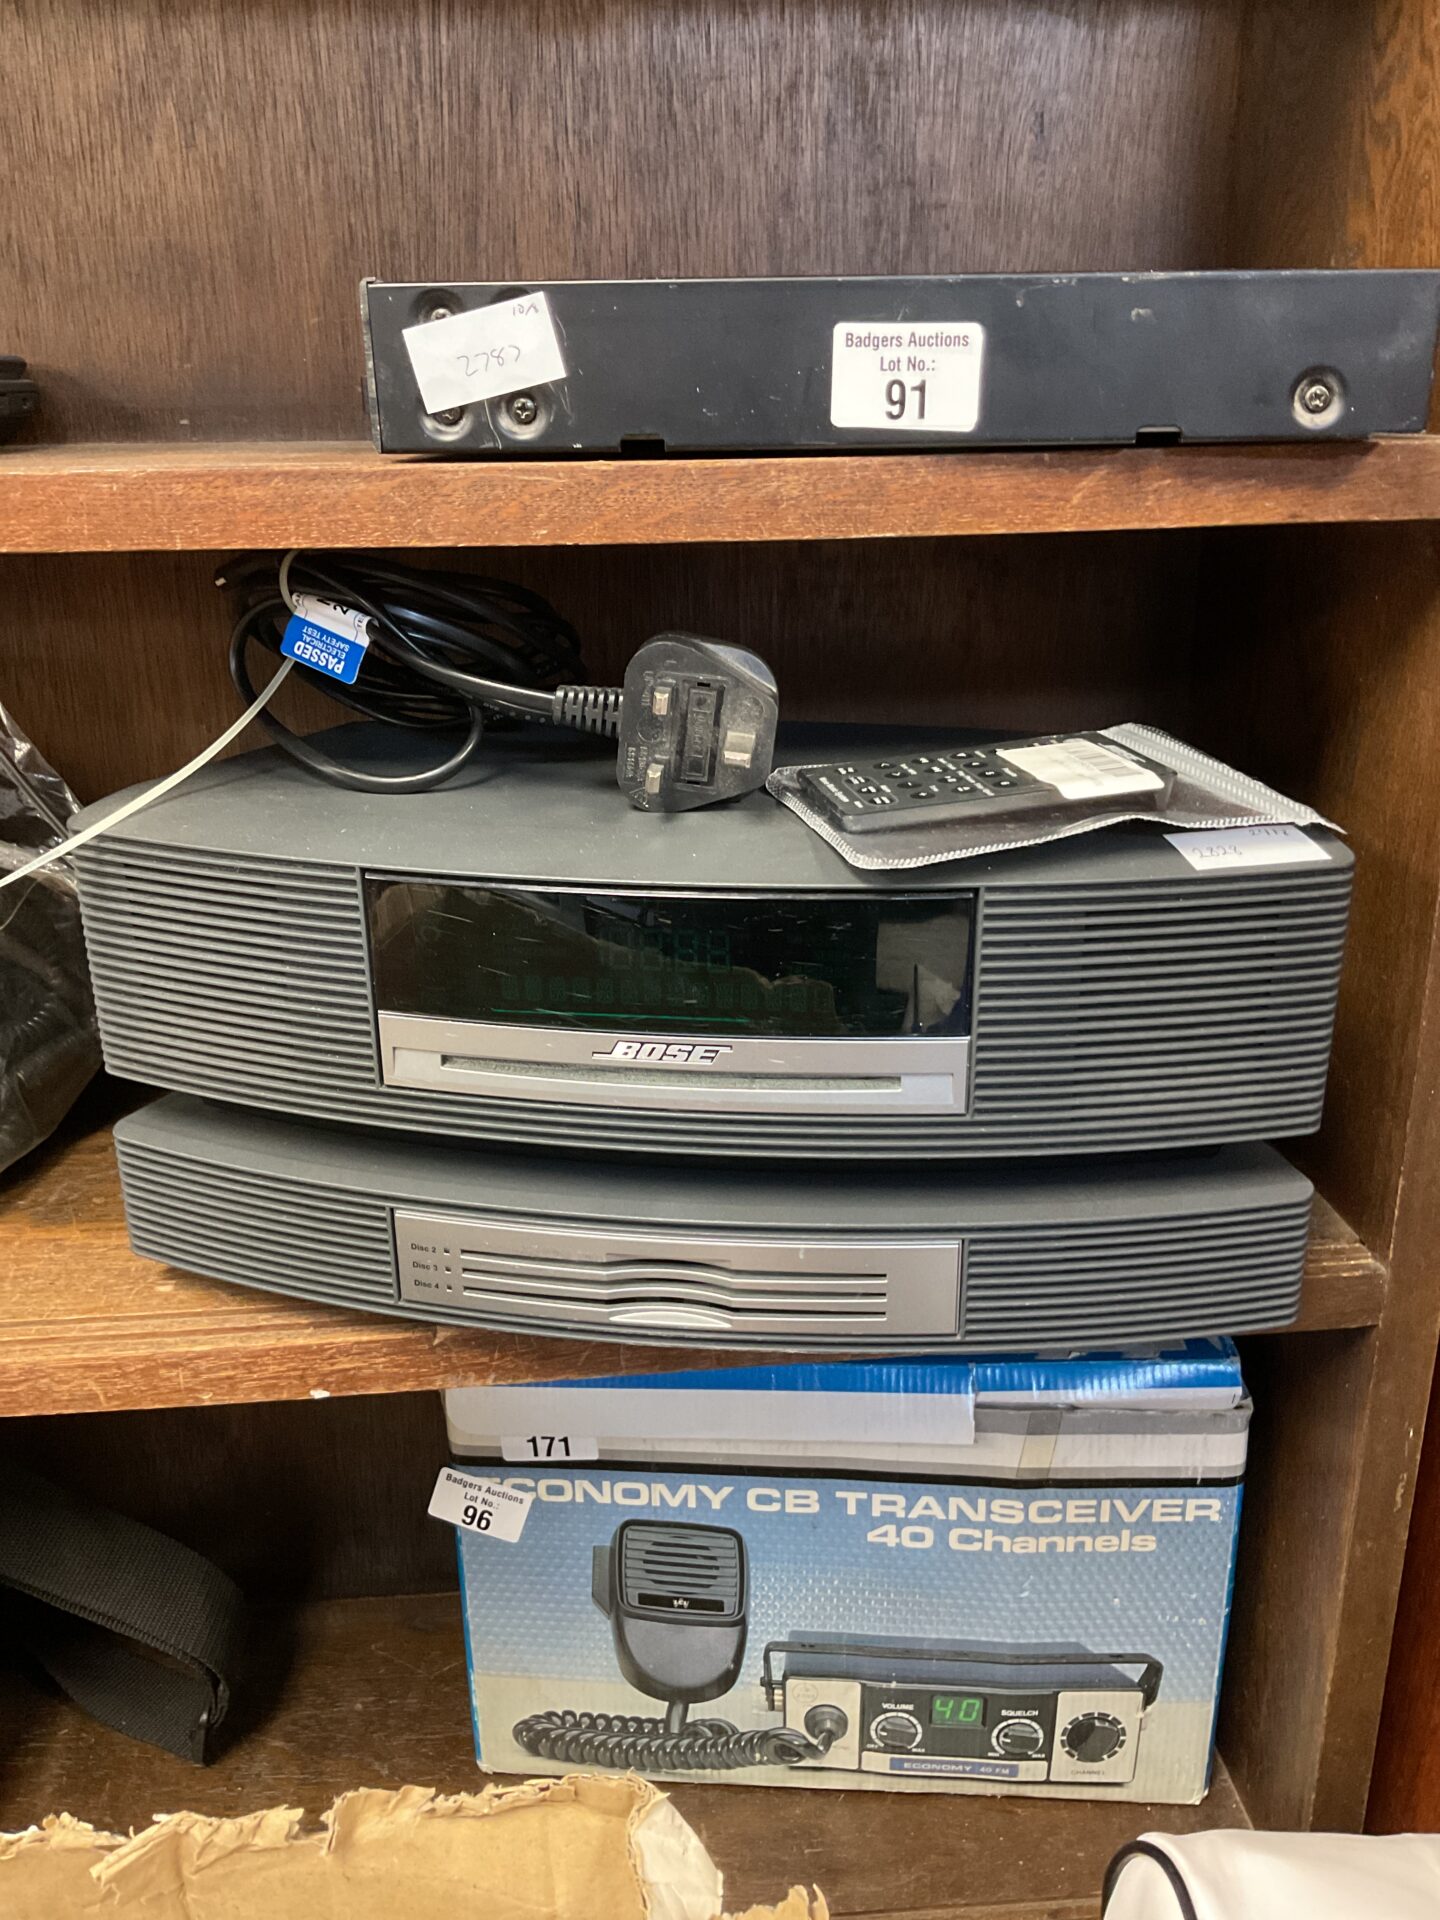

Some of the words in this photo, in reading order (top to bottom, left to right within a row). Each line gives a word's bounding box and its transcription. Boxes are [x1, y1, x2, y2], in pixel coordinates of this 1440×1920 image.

[845, 332, 903, 351] Badgers
[908, 332, 969, 347] Auctions
[880, 356, 902, 371] Lot
[907, 356, 936, 371] No.:
[885, 378, 926, 420] 91
[302, 625, 320, 639] TEST
[302, 633, 346, 659] ELECTRICAL
[321, 634, 350, 652] SAFETY
[294, 641, 345, 674] PASSED
[605, 1040, 728, 1064] BOSE
[410, 1243, 429, 1253] Disc
[412, 1261, 431, 1271] Disc
[414, 1279, 433, 1289] Disc
[526, 1436, 570, 1457] 171
[445, 1473, 482, 1493] Badgers
[484, 1486, 525, 1505] Auctions
[464, 1491, 479, 1503] Lot
[747, 1487, 820, 1514] CB
[835, 1491, 1222, 1524] TRANSCEIVER
[461, 1505, 493, 1531] 96
[867, 1524, 933, 1549] 40
[948, 1527, 1157, 1553] Channels
[882, 1702, 914, 1711] VOLUME
[935, 1699, 980, 1721] 40
[1001, 1709, 1039, 1717] SQUELCH
[903, 1762, 972, 1772] ECONOMY
[979, 1766, 992, 1774] 40
[995, 1767, 1010, 1775] FM
